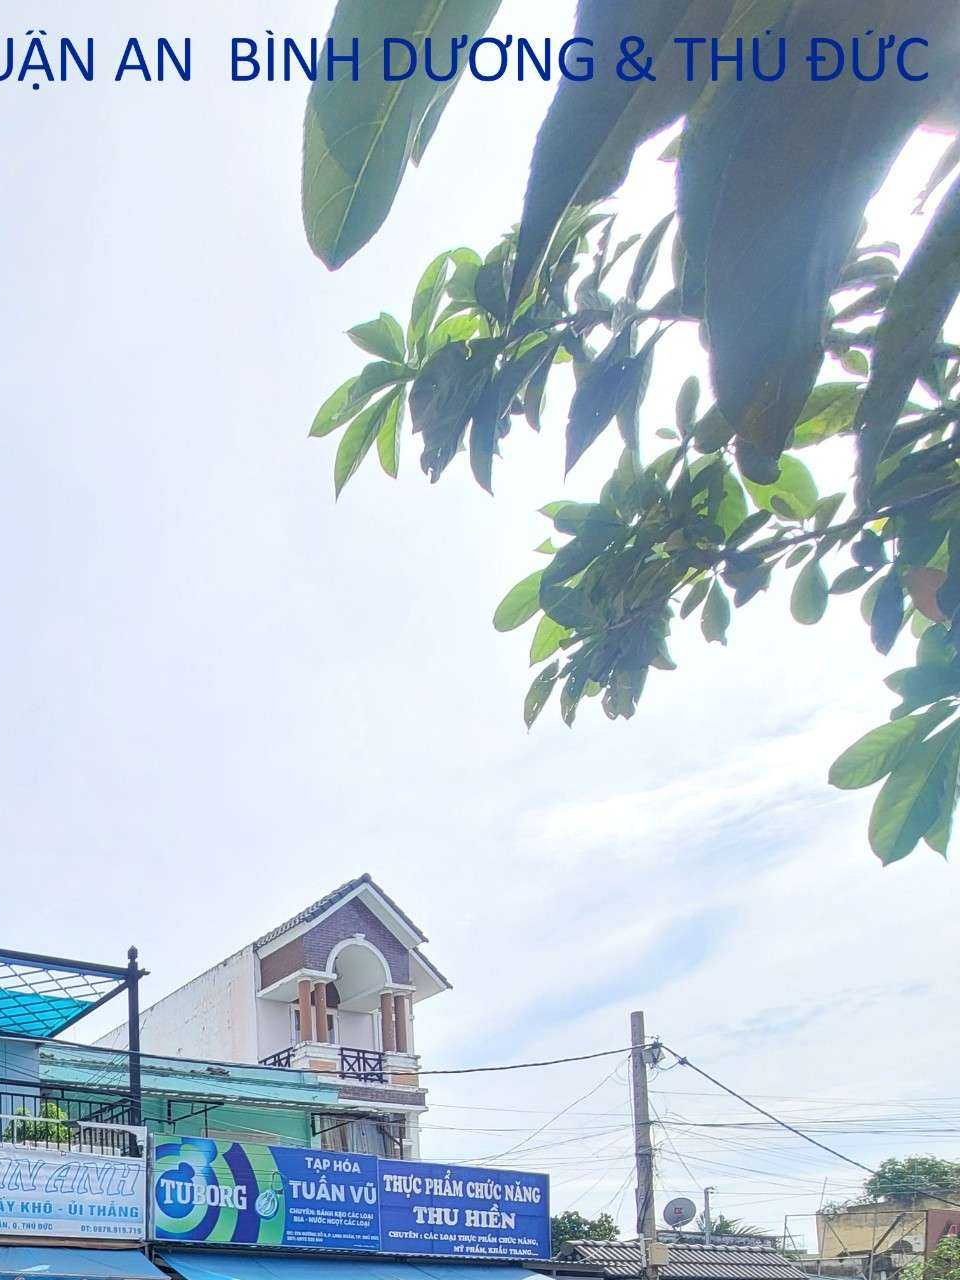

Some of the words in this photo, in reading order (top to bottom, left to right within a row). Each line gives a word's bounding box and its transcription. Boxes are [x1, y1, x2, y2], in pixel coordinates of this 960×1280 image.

[44, 1158, 141, 1197] ANH
[305, 1157, 331, 1174] TẠP
[333, 1158, 361, 1174] HÓA
[160, 1176, 248, 1210] TUBORG
[350, 1182, 377, 1205] VŨ
[383, 1174, 422, 1199] THỰC
[425, 1169, 464, 1198] PHẨM
[466, 1178, 502, 1202] CHỨC
[504, 1182, 542, 1204] NĂNG
[413, 1205, 460, 1226] THU
[465, 1203, 517, 1230] HIỀN
[423, 1231, 439, 1241] CÁC
[439, 1232, 457, 1242] LOẠI
[457, 1233, 477, 1244] THỰC
